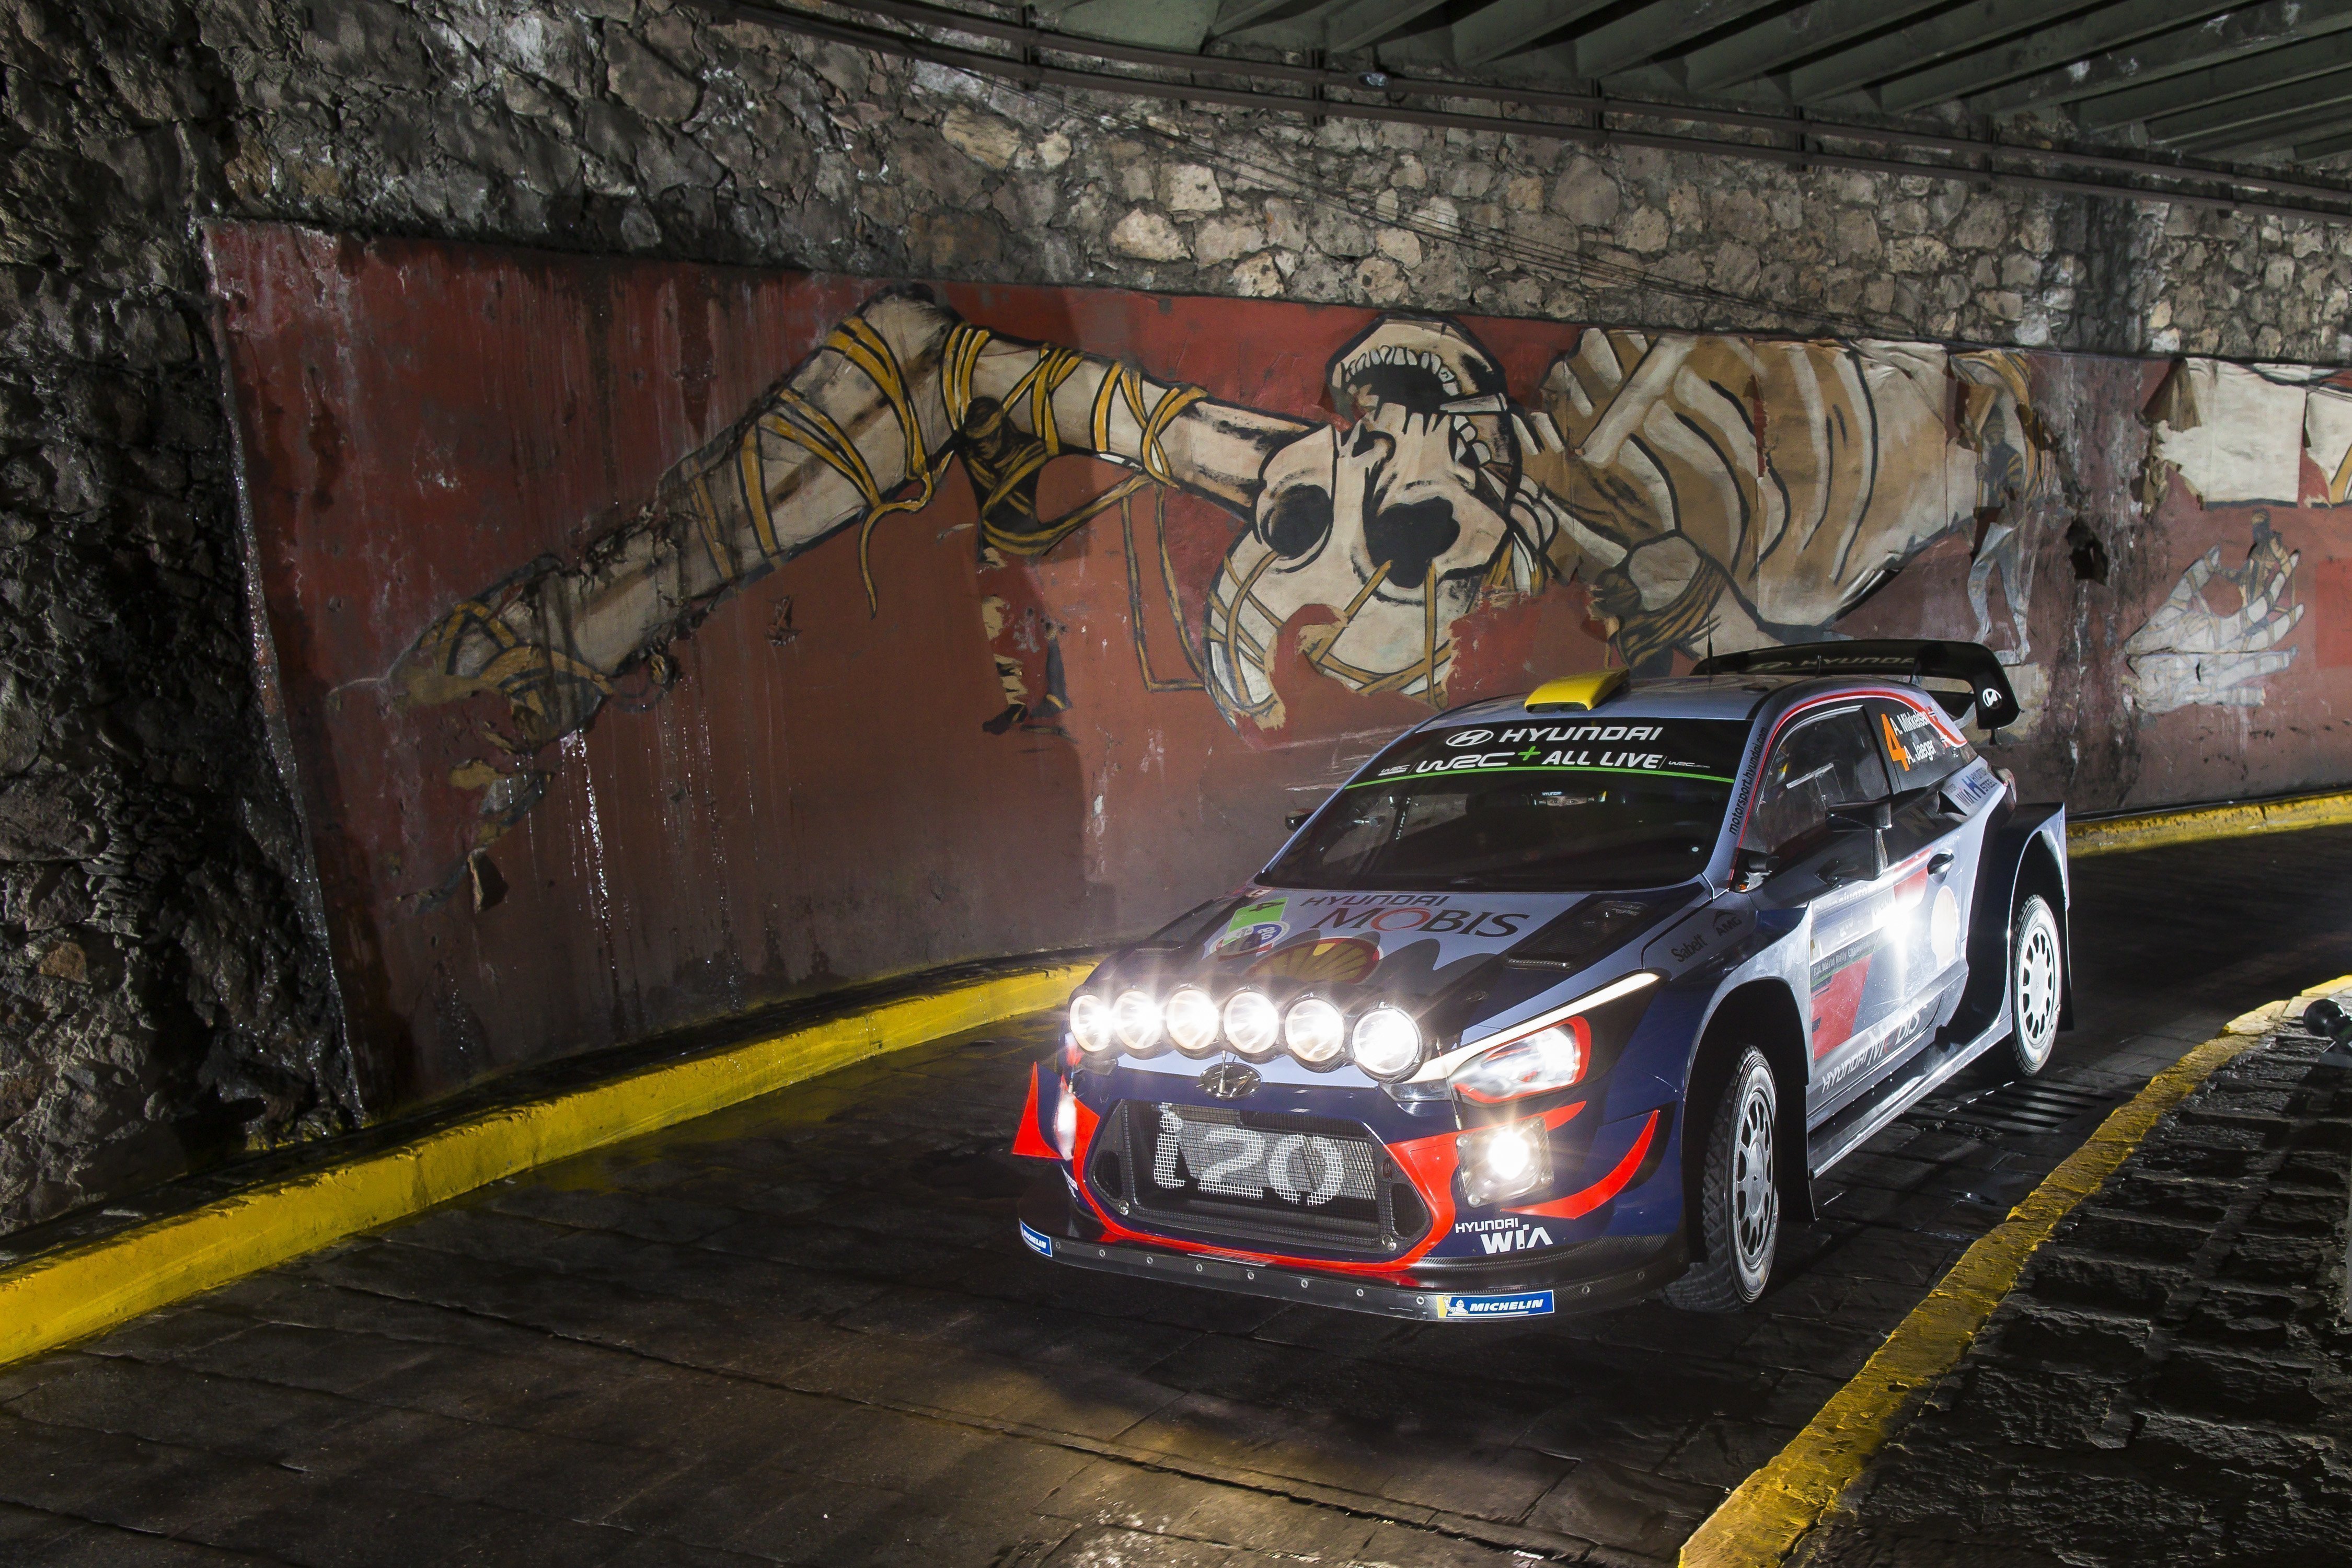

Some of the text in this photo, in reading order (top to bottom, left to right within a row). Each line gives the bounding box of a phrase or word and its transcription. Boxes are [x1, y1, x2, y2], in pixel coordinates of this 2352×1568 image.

[1498, 727, 1663, 742] HYUNDAI
[1889, 710, 1930, 736] A. Mikkelsen
[1881, 713, 1910, 771] 4
[1903, 740, 1937, 765] A. Jaeger
[1541, 751, 1592, 765] ALL
[1599, 752, 1664, 769] LIVE
[1728, 726, 1769, 836] motorsport.hyundai.com
[1979, 778, 1998, 792] STEEL
[1249, 902, 1285, 912] 4
[1300, 894, 1450, 907] HYUNDAI
[1309, 907, 1531, 938] MOBIS
[1671, 934, 1708, 962] Sabelt
[1821, 1045, 1871, 1094] HYUNDAI
[1455, 1218, 1519, 1233] HYUNDAI
[1480, 1224, 1553, 1254] WIA
[1469, 1299, 1544, 1312] MICHELIN
